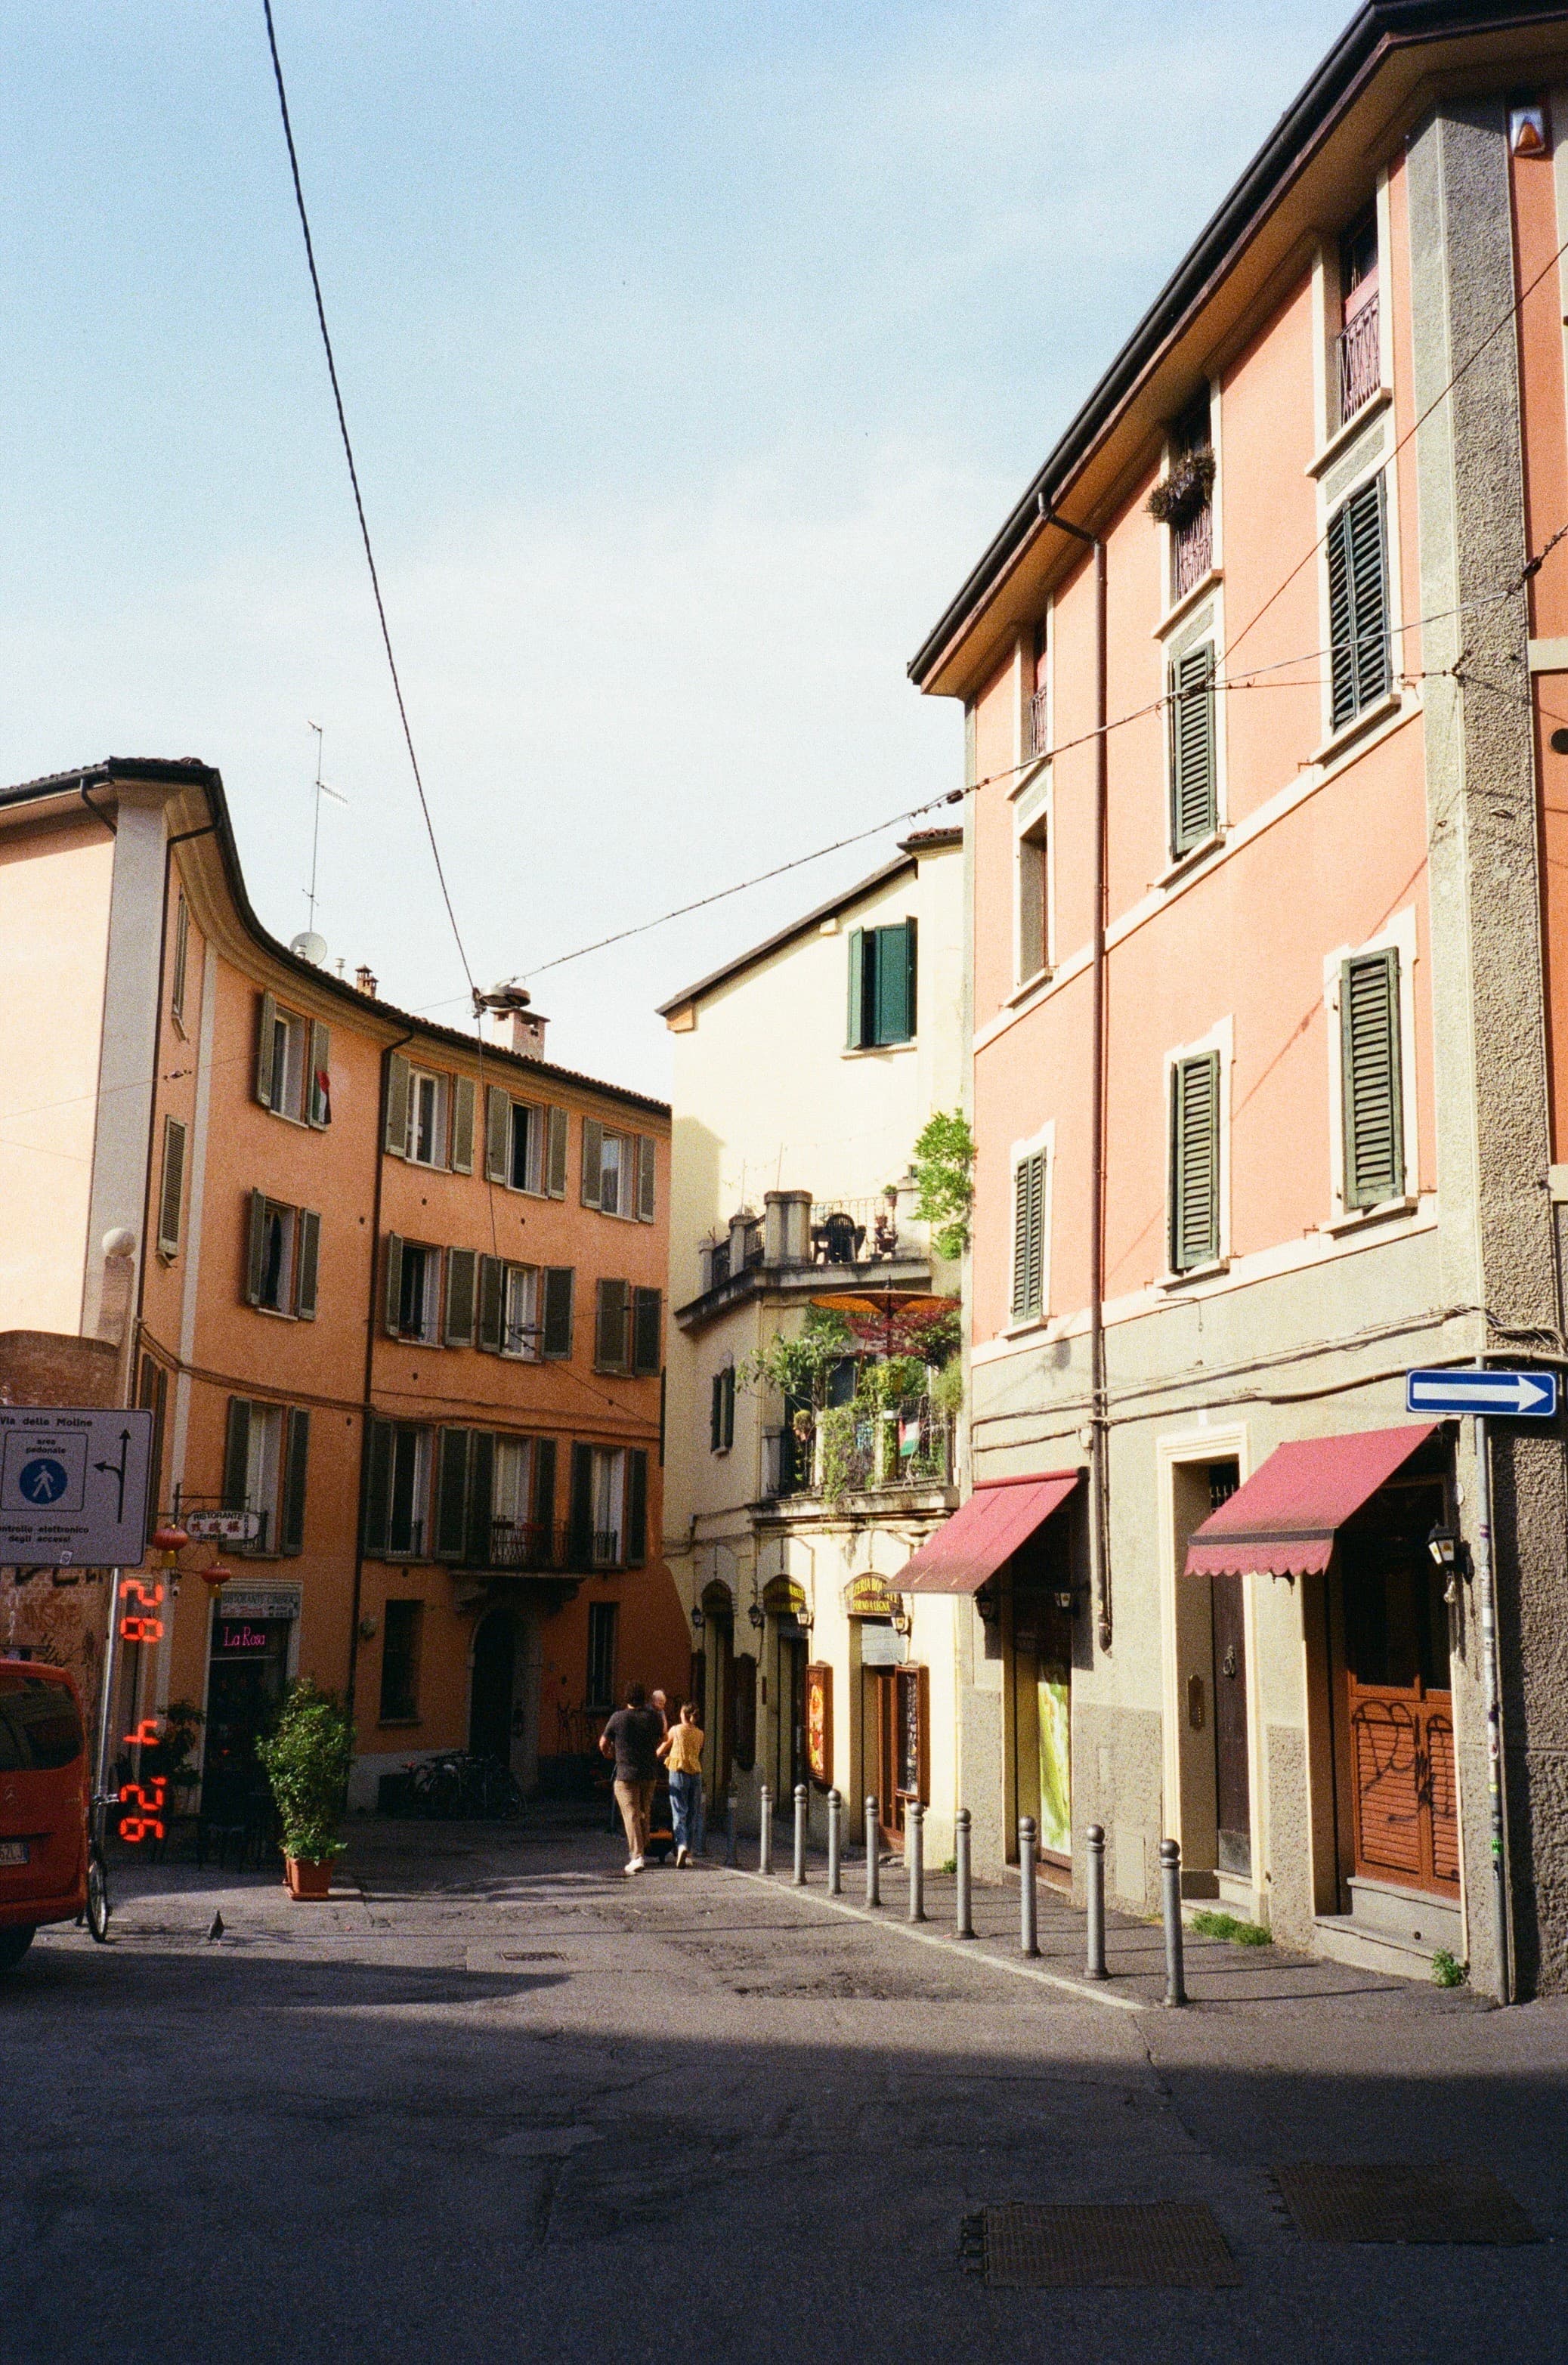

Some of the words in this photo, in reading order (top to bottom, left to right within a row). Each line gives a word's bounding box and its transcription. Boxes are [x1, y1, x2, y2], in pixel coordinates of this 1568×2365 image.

[0, 1417, 15, 1425] Via
[23, 1417, 50, 1426] delle
[57, 1418, 93, 1427] Moline
[193, 1511, 243, 1521] RISTORANTE
[38, 1526, 89, 1534] elettronico
[8, 1535, 32, 1544] degli
[224, 1626, 240, 1646] La
[242, 1626, 266, 1646] Rosa
